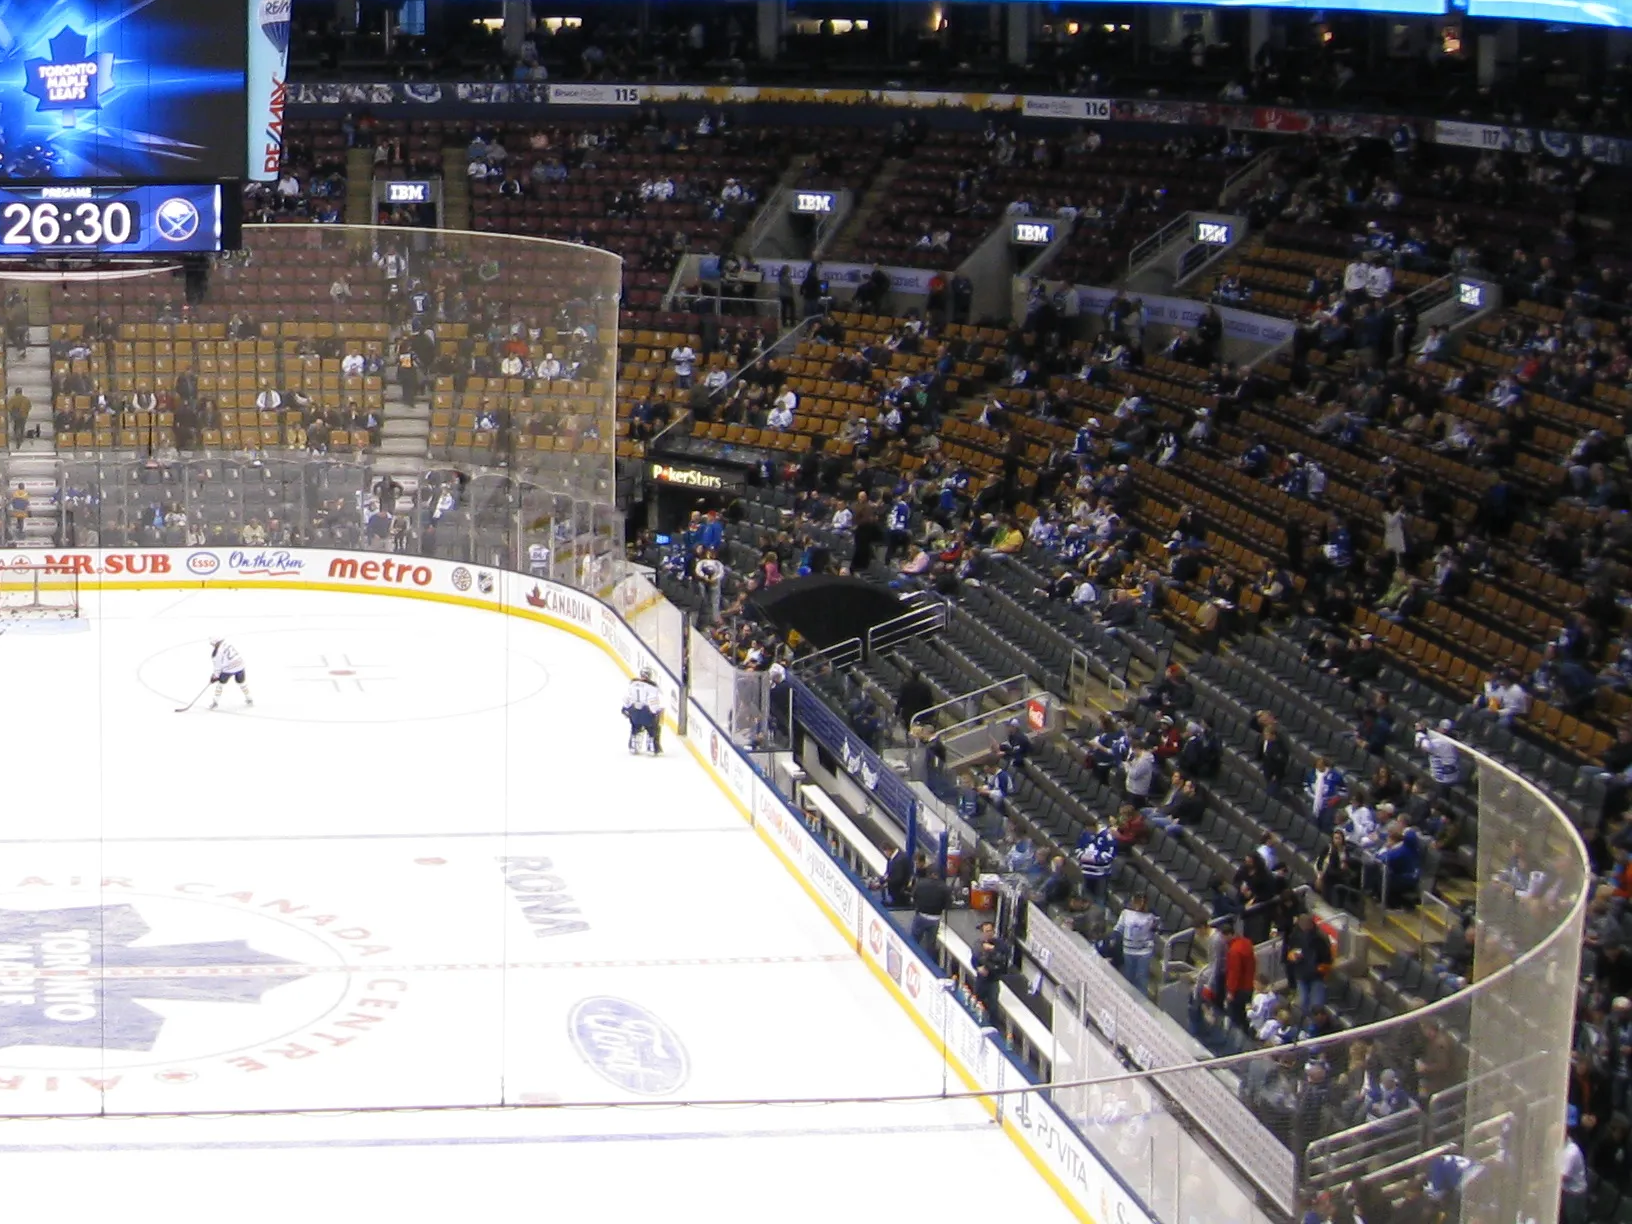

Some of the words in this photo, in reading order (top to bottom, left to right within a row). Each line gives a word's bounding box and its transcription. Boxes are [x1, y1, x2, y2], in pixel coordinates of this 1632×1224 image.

[39, 62, 97, 79] TORONTO
[47, 75, 89, 89] MAPLE
[49, 87, 86, 101] LEAFS
[554, 88, 579, 97] Bruce
[615, 88, 637, 101] 115
[1085, 102, 1108, 116] 116
[264, 77, 288, 173] RE/MAX
[41, 187, 92, 199] PREGAME
[390, 183, 424, 201] IBM
[797, 194, 831, 212] IBM
[3, 202, 132, 245] 26:30
[1016, 223, 1049, 242] IBM
[1198, 223, 1229, 243] IBM
[228, 551, 251, 569] On
[251, 552, 274, 569] the
[273, 551, 305, 570] Run
[328, 558, 433, 586] metro
[544, 590, 593, 625] CANADIAN
[719, 743, 730, 776] LG
[784, 822, 803, 860] RAMA
[17, 875, 136, 891] AIR
[172, 880, 394, 960] CANADA
[226, 977, 410, 1075] CENTRE
